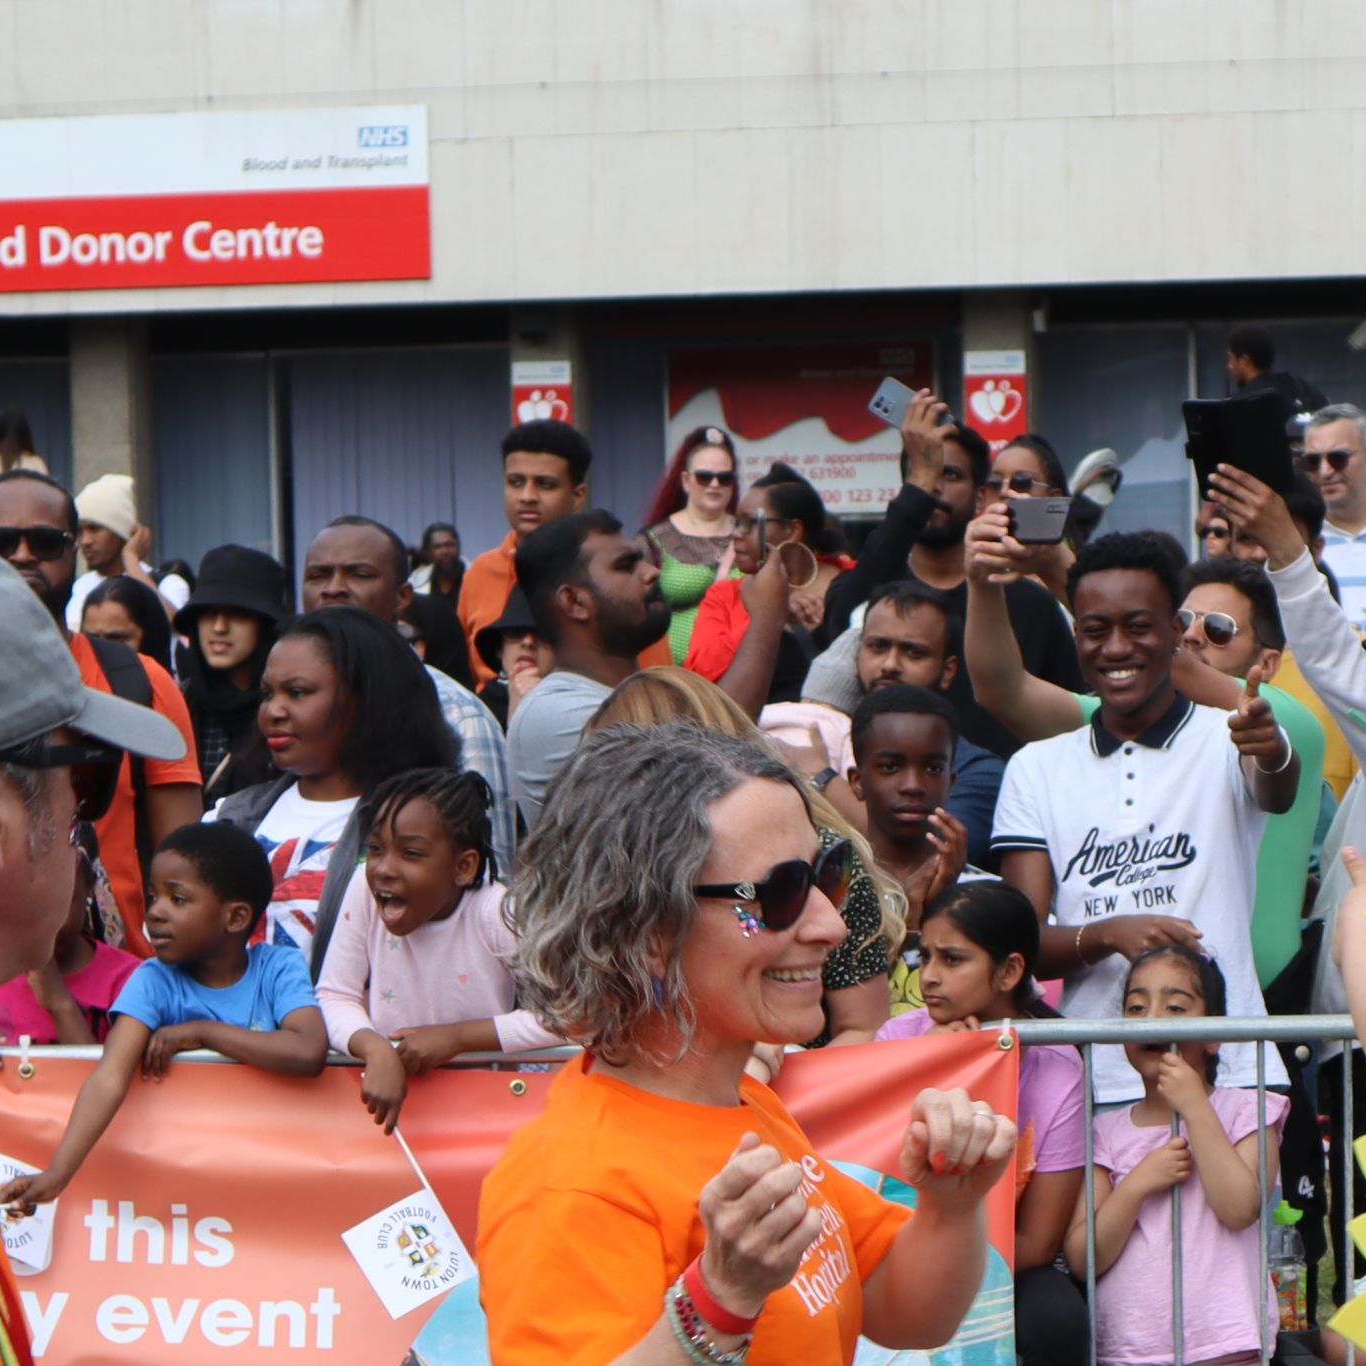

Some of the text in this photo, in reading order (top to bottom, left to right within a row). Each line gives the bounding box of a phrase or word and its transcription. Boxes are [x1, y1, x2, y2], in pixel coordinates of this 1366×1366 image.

[361, 127, 405, 146] NHS
[242, 154, 408, 172] Blood and Transplant
[39, 224, 171, 267] Donor
[183, 219, 324, 262] Centre
[1061, 823, 1197, 883] American
[1084, 885, 1177, 918] NEW YORK
[3, 1231, 33, 1250] LUTO
[84, 1199, 235, 1268] this
[376, 1206, 437, 1250] FOOTBALL CLUB
[400, 1250, 460, 1292] LUTON TOWN
[96, 1287, 341, 1349] event
